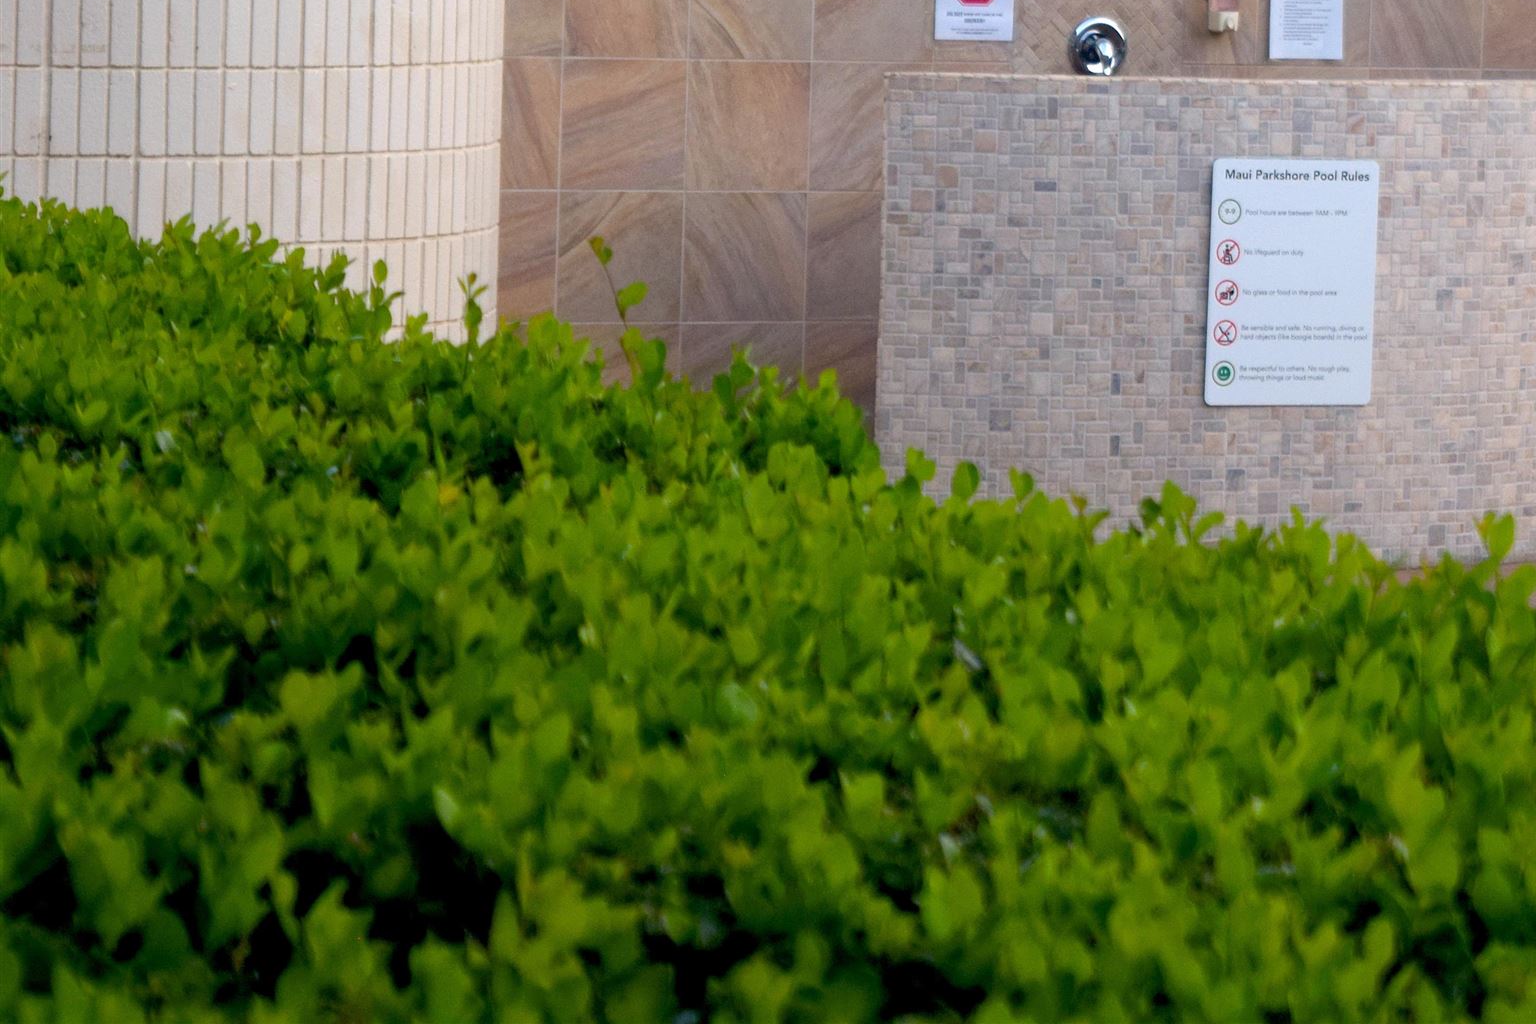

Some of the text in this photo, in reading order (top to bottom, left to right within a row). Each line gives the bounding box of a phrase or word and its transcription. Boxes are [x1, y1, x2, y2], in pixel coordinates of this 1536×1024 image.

[1225, 169, 1370, 181] Maui Parkshore Pool Rules
[1291, 249, 1304, 258] duty
[1253, 289, 1268, 297] glass
